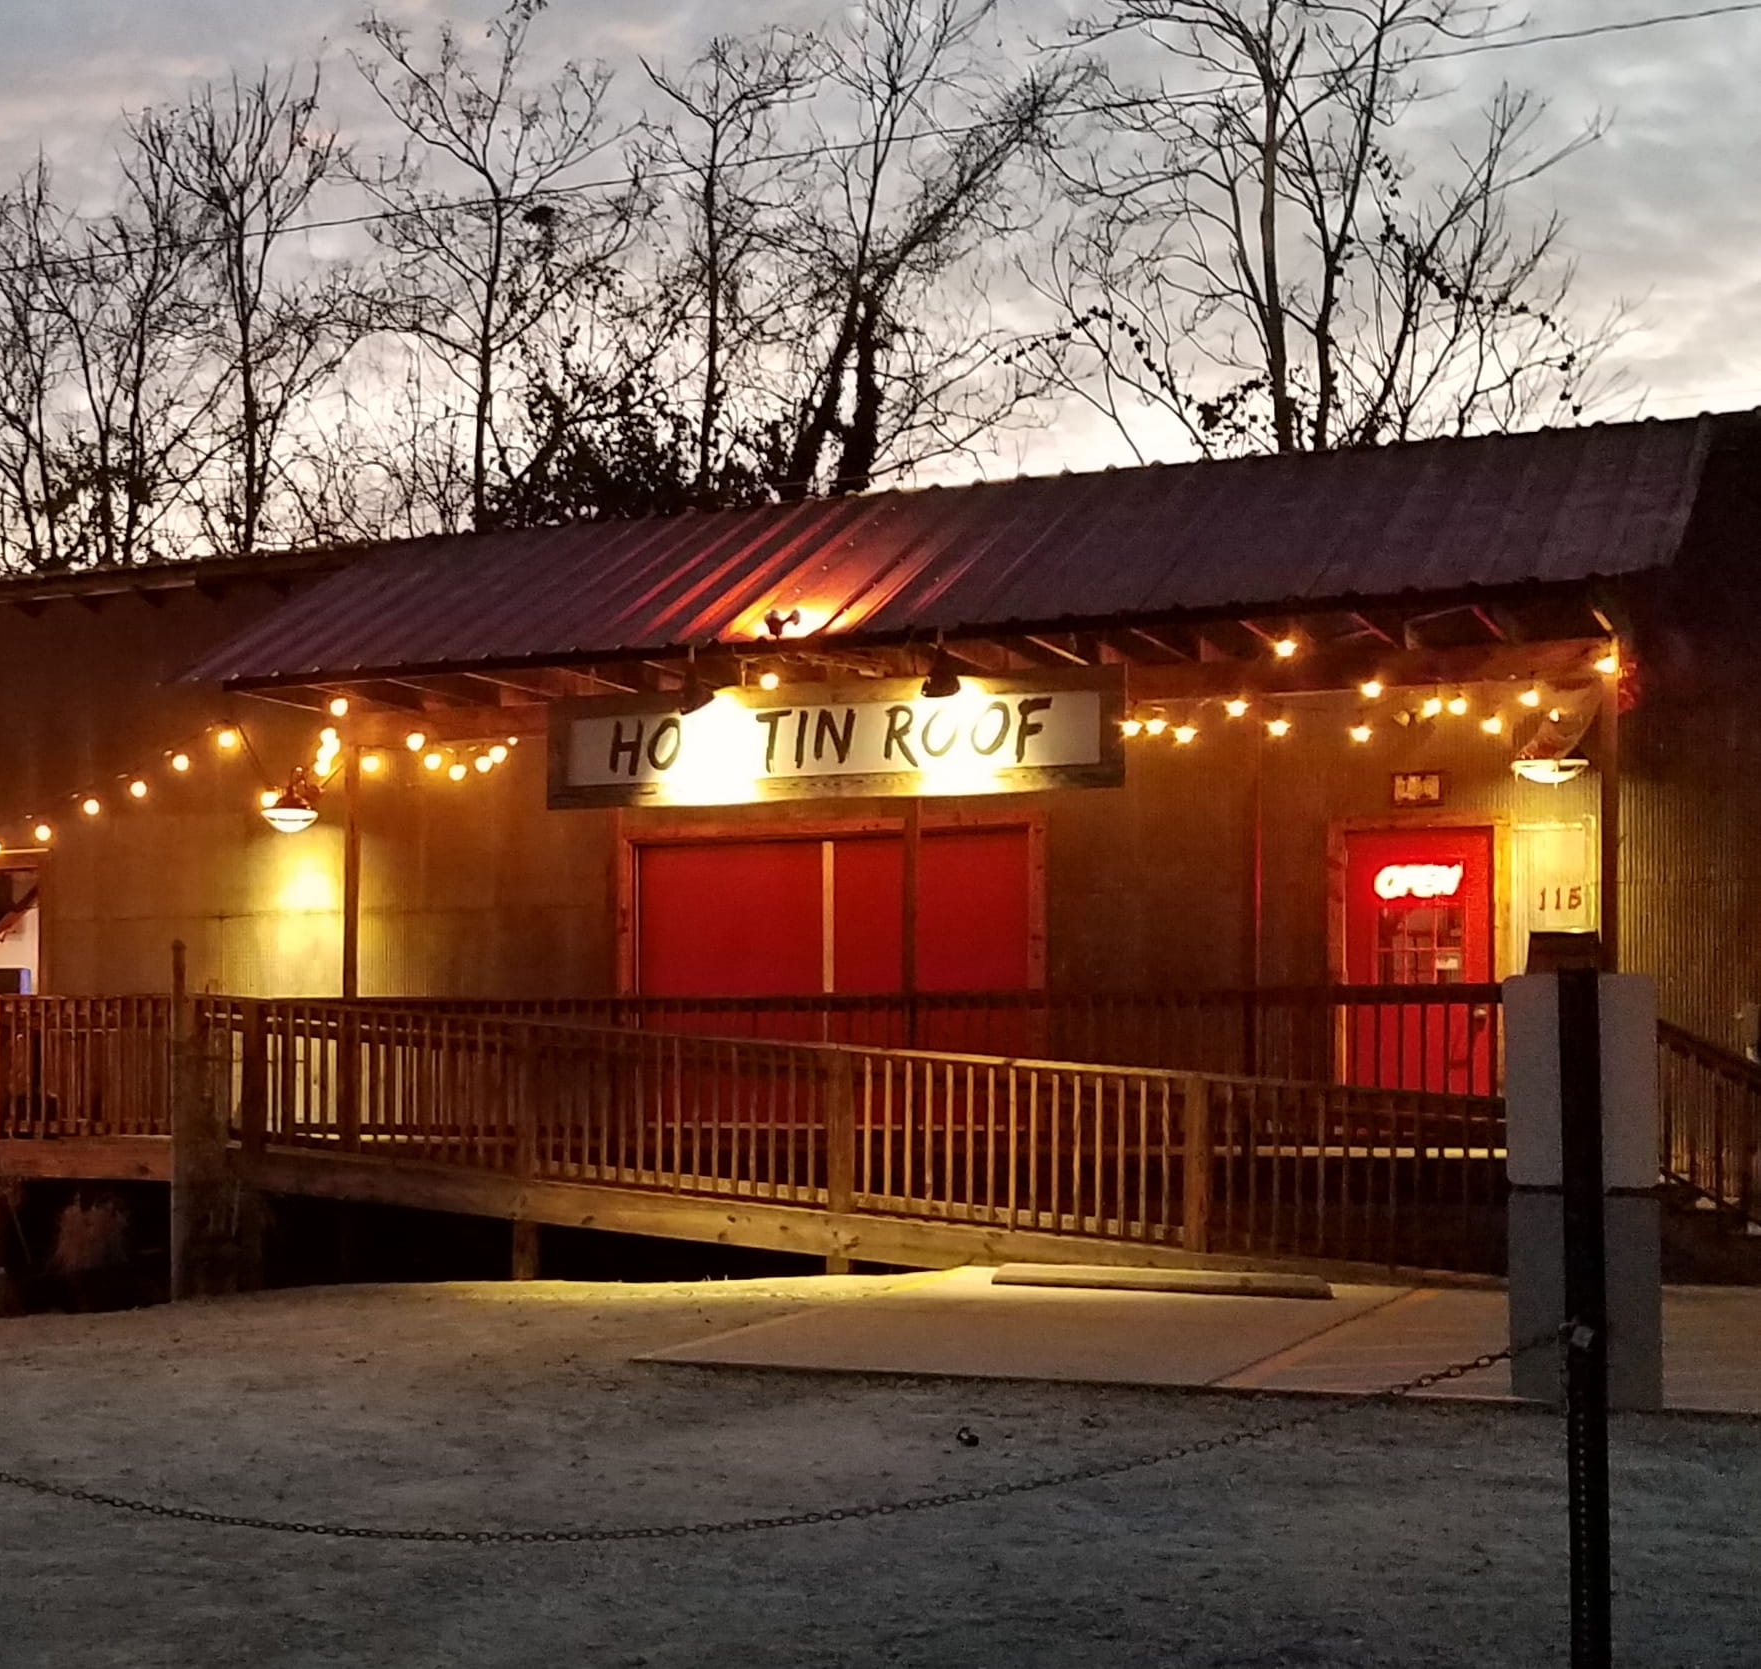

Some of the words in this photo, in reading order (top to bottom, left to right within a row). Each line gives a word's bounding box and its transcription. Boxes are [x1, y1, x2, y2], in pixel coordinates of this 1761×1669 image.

[609, 717, 703, 776] HO
[755, 708, 855, 774] TIN
[883, 697, 1053, 768] ROOF
[1375, 861, 1463, 899] OPEN
[1539, 886, 1582, 911] 115
